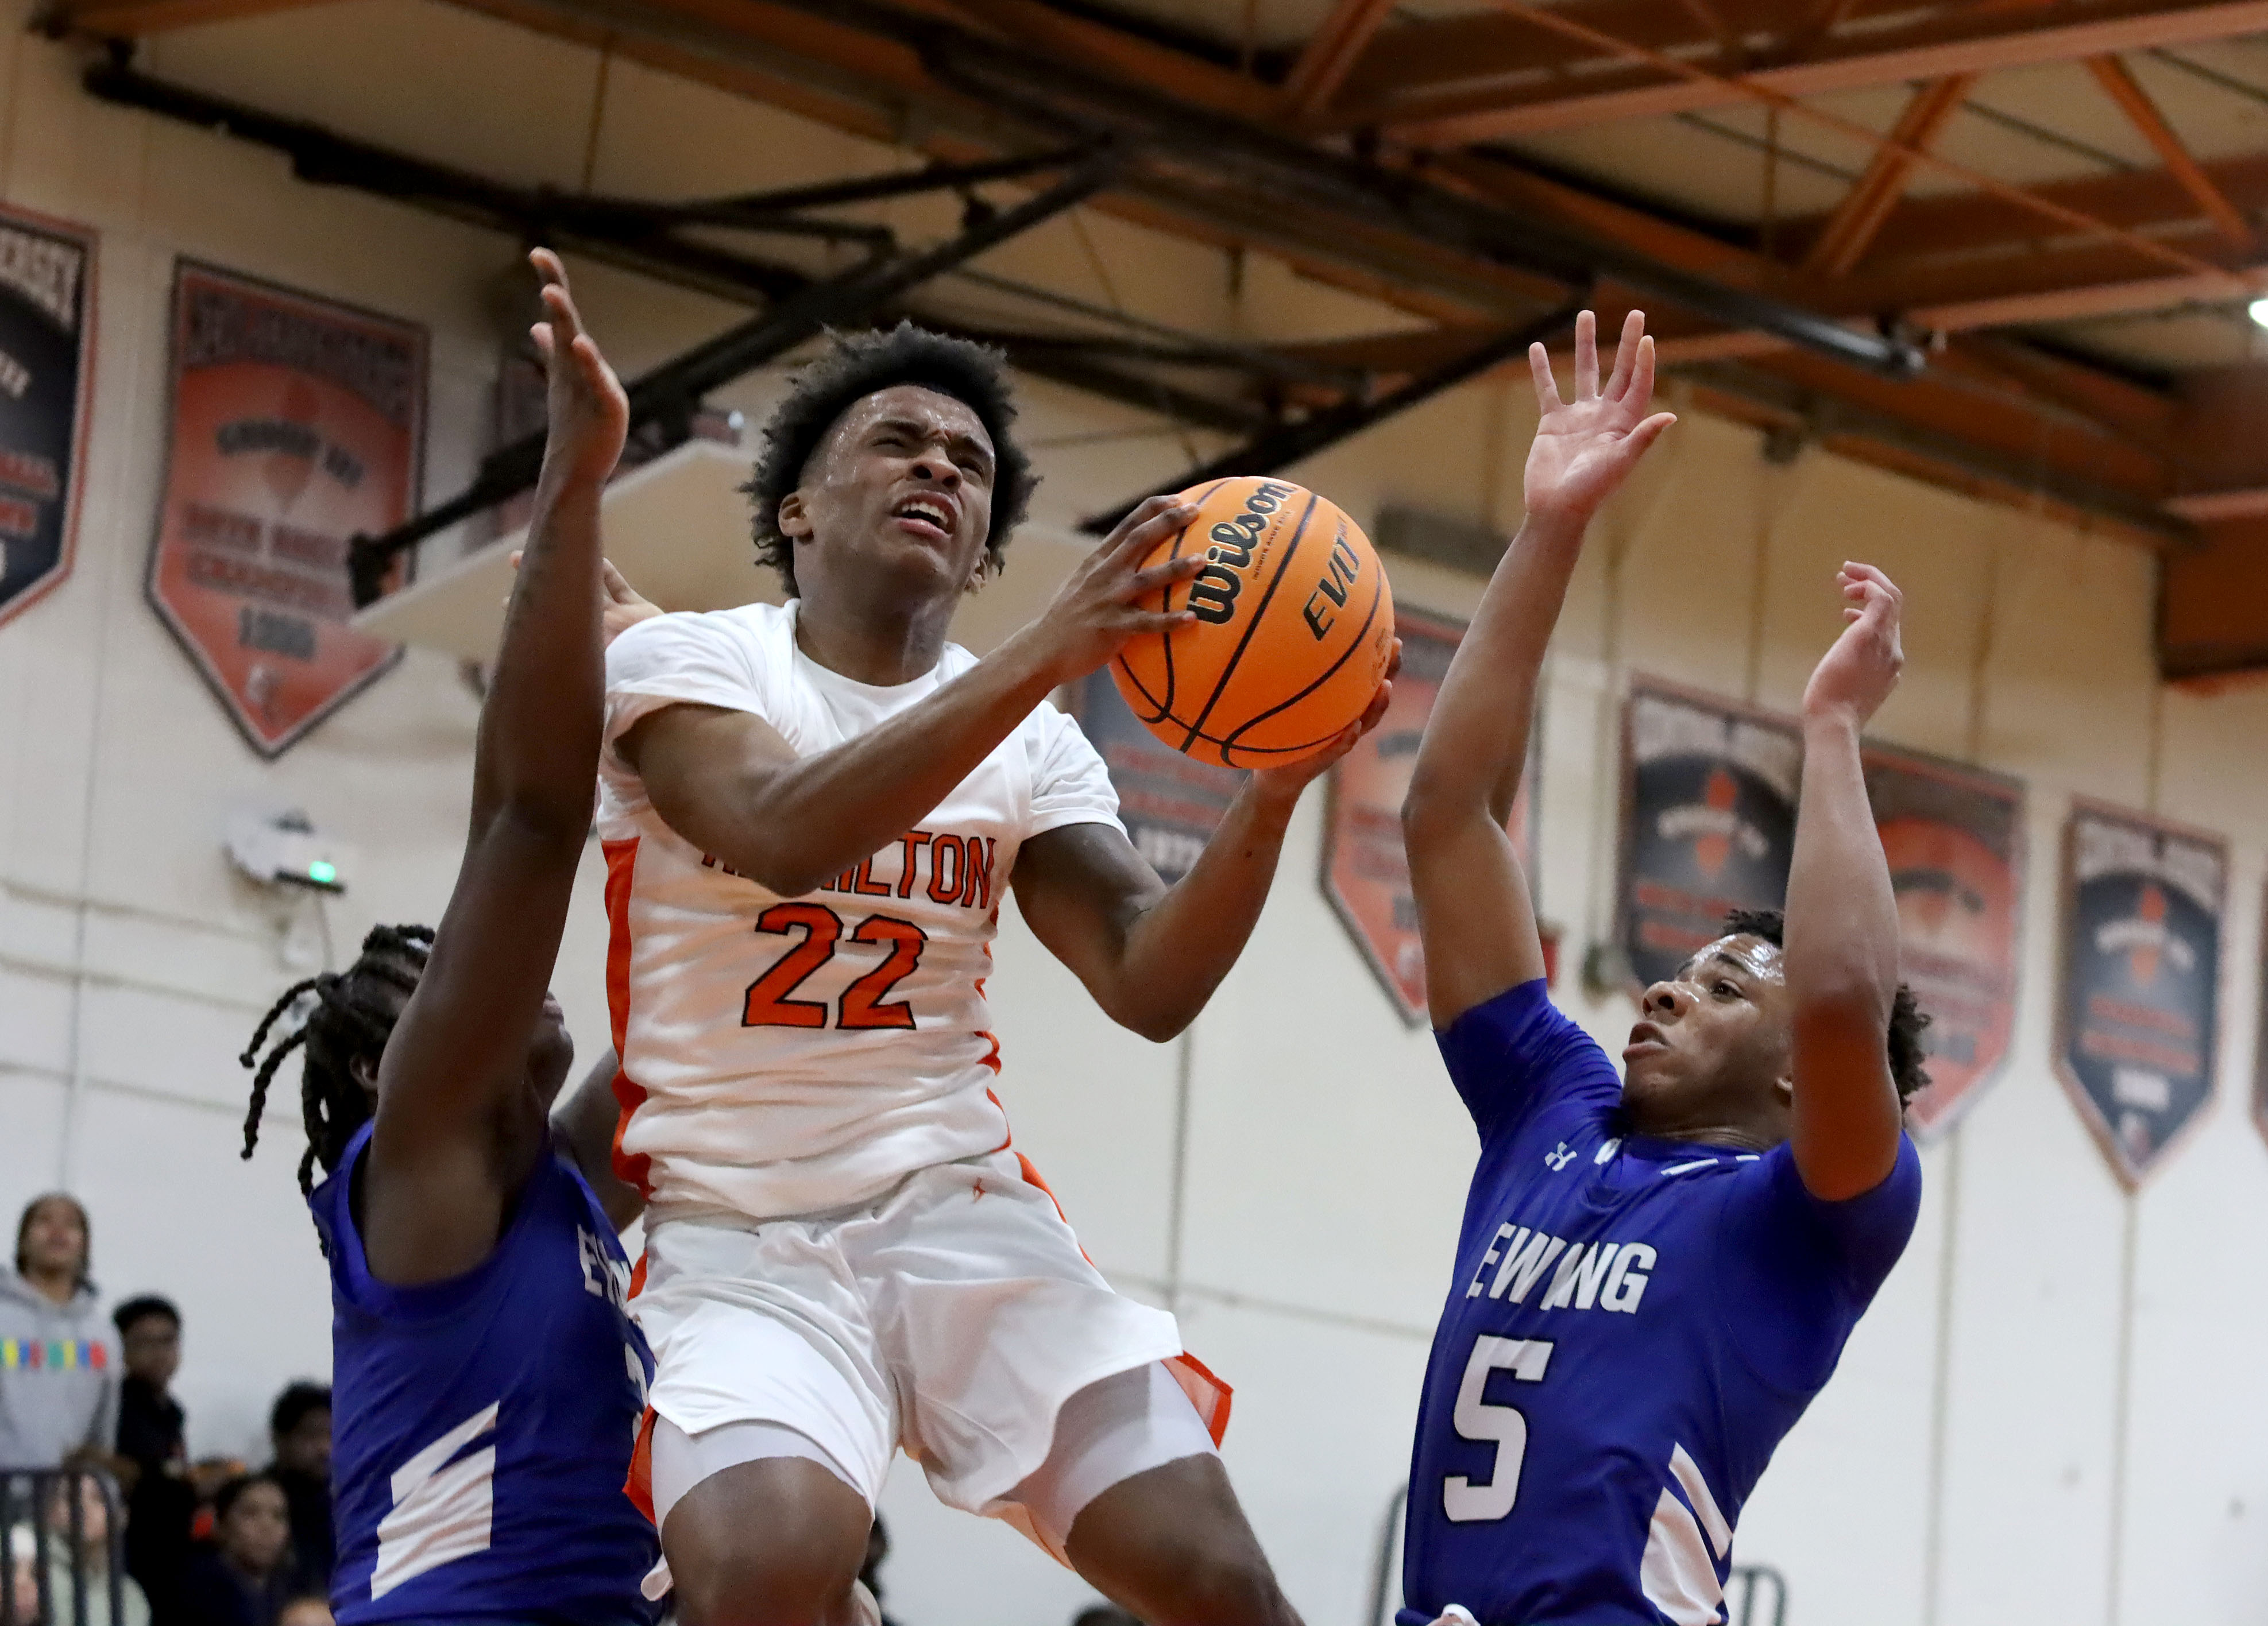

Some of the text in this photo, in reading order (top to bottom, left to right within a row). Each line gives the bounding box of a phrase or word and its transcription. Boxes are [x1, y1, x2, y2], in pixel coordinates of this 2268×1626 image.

[1187, 482, 1297, 625] Wilson
[1303, 534, 1360, 642] EVO
[701, 830, 996, 909] LTON
[741, 901, 929, 1031] 22
[1466, 1221, 1657, 1315] EWING
[1443, 1334, 1554, 1522] 5
